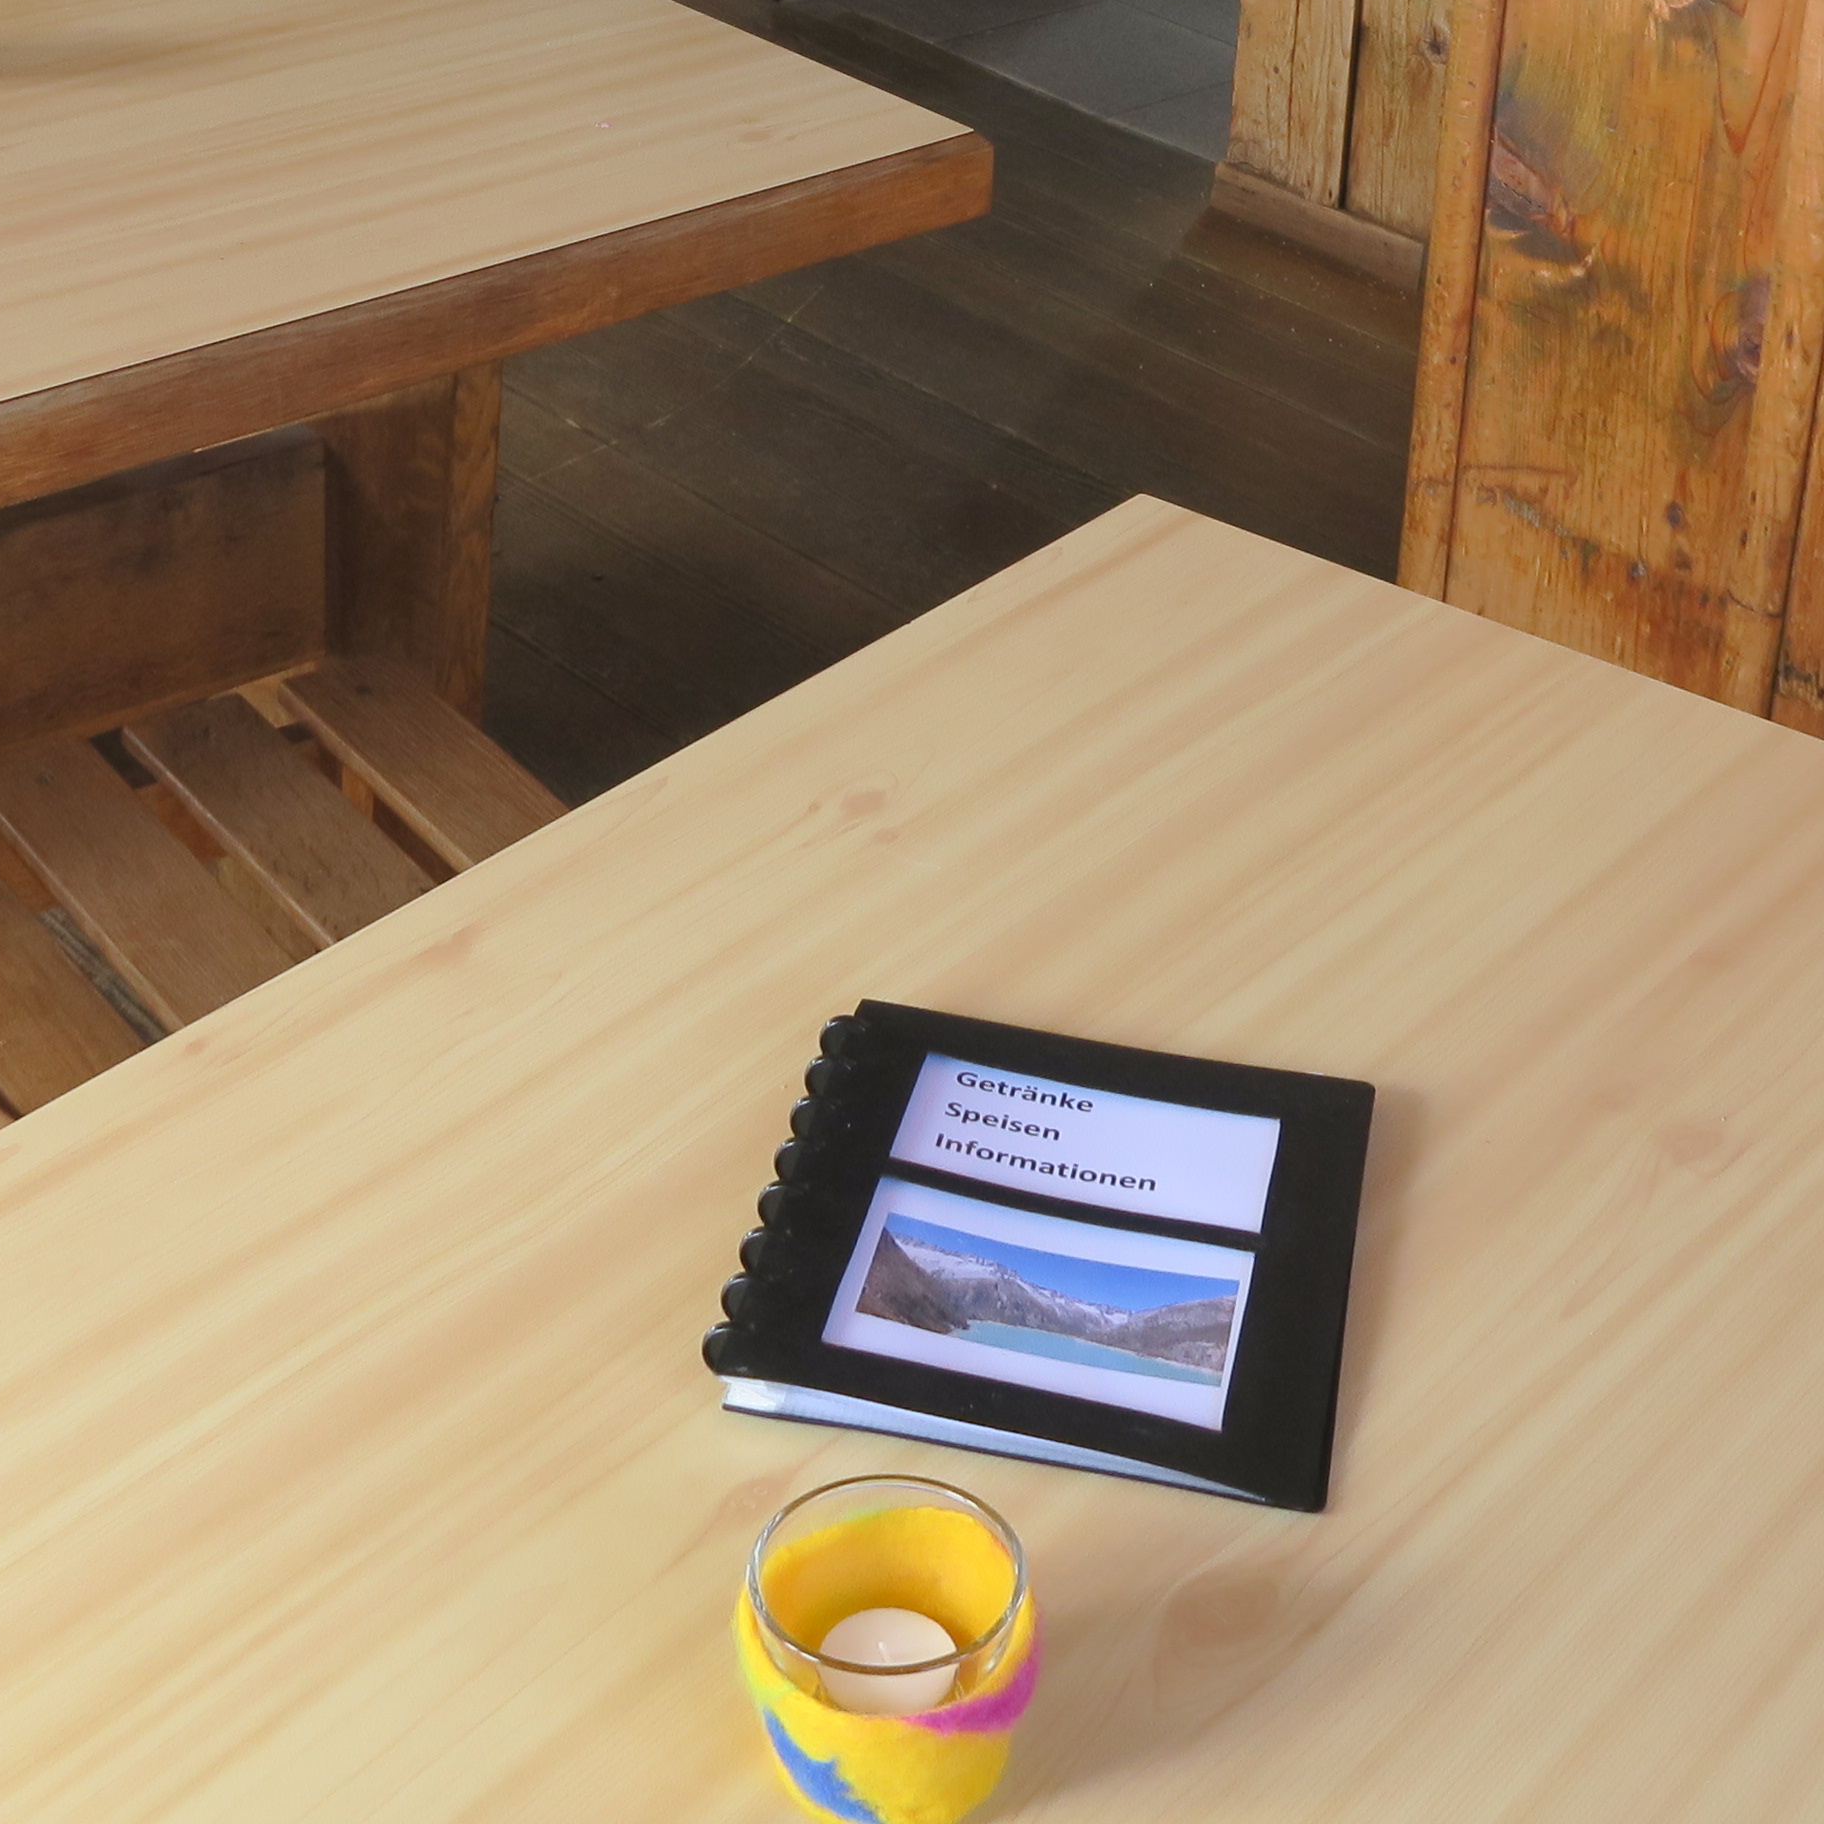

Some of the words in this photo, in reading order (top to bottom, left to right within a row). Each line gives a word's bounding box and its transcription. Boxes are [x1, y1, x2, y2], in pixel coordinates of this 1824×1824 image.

[955, 1070, 1095, 1113] Getränke
[943, 1101, 1061, 1142] Speisen
[934, 1132, 1158, 1192] Informationen
